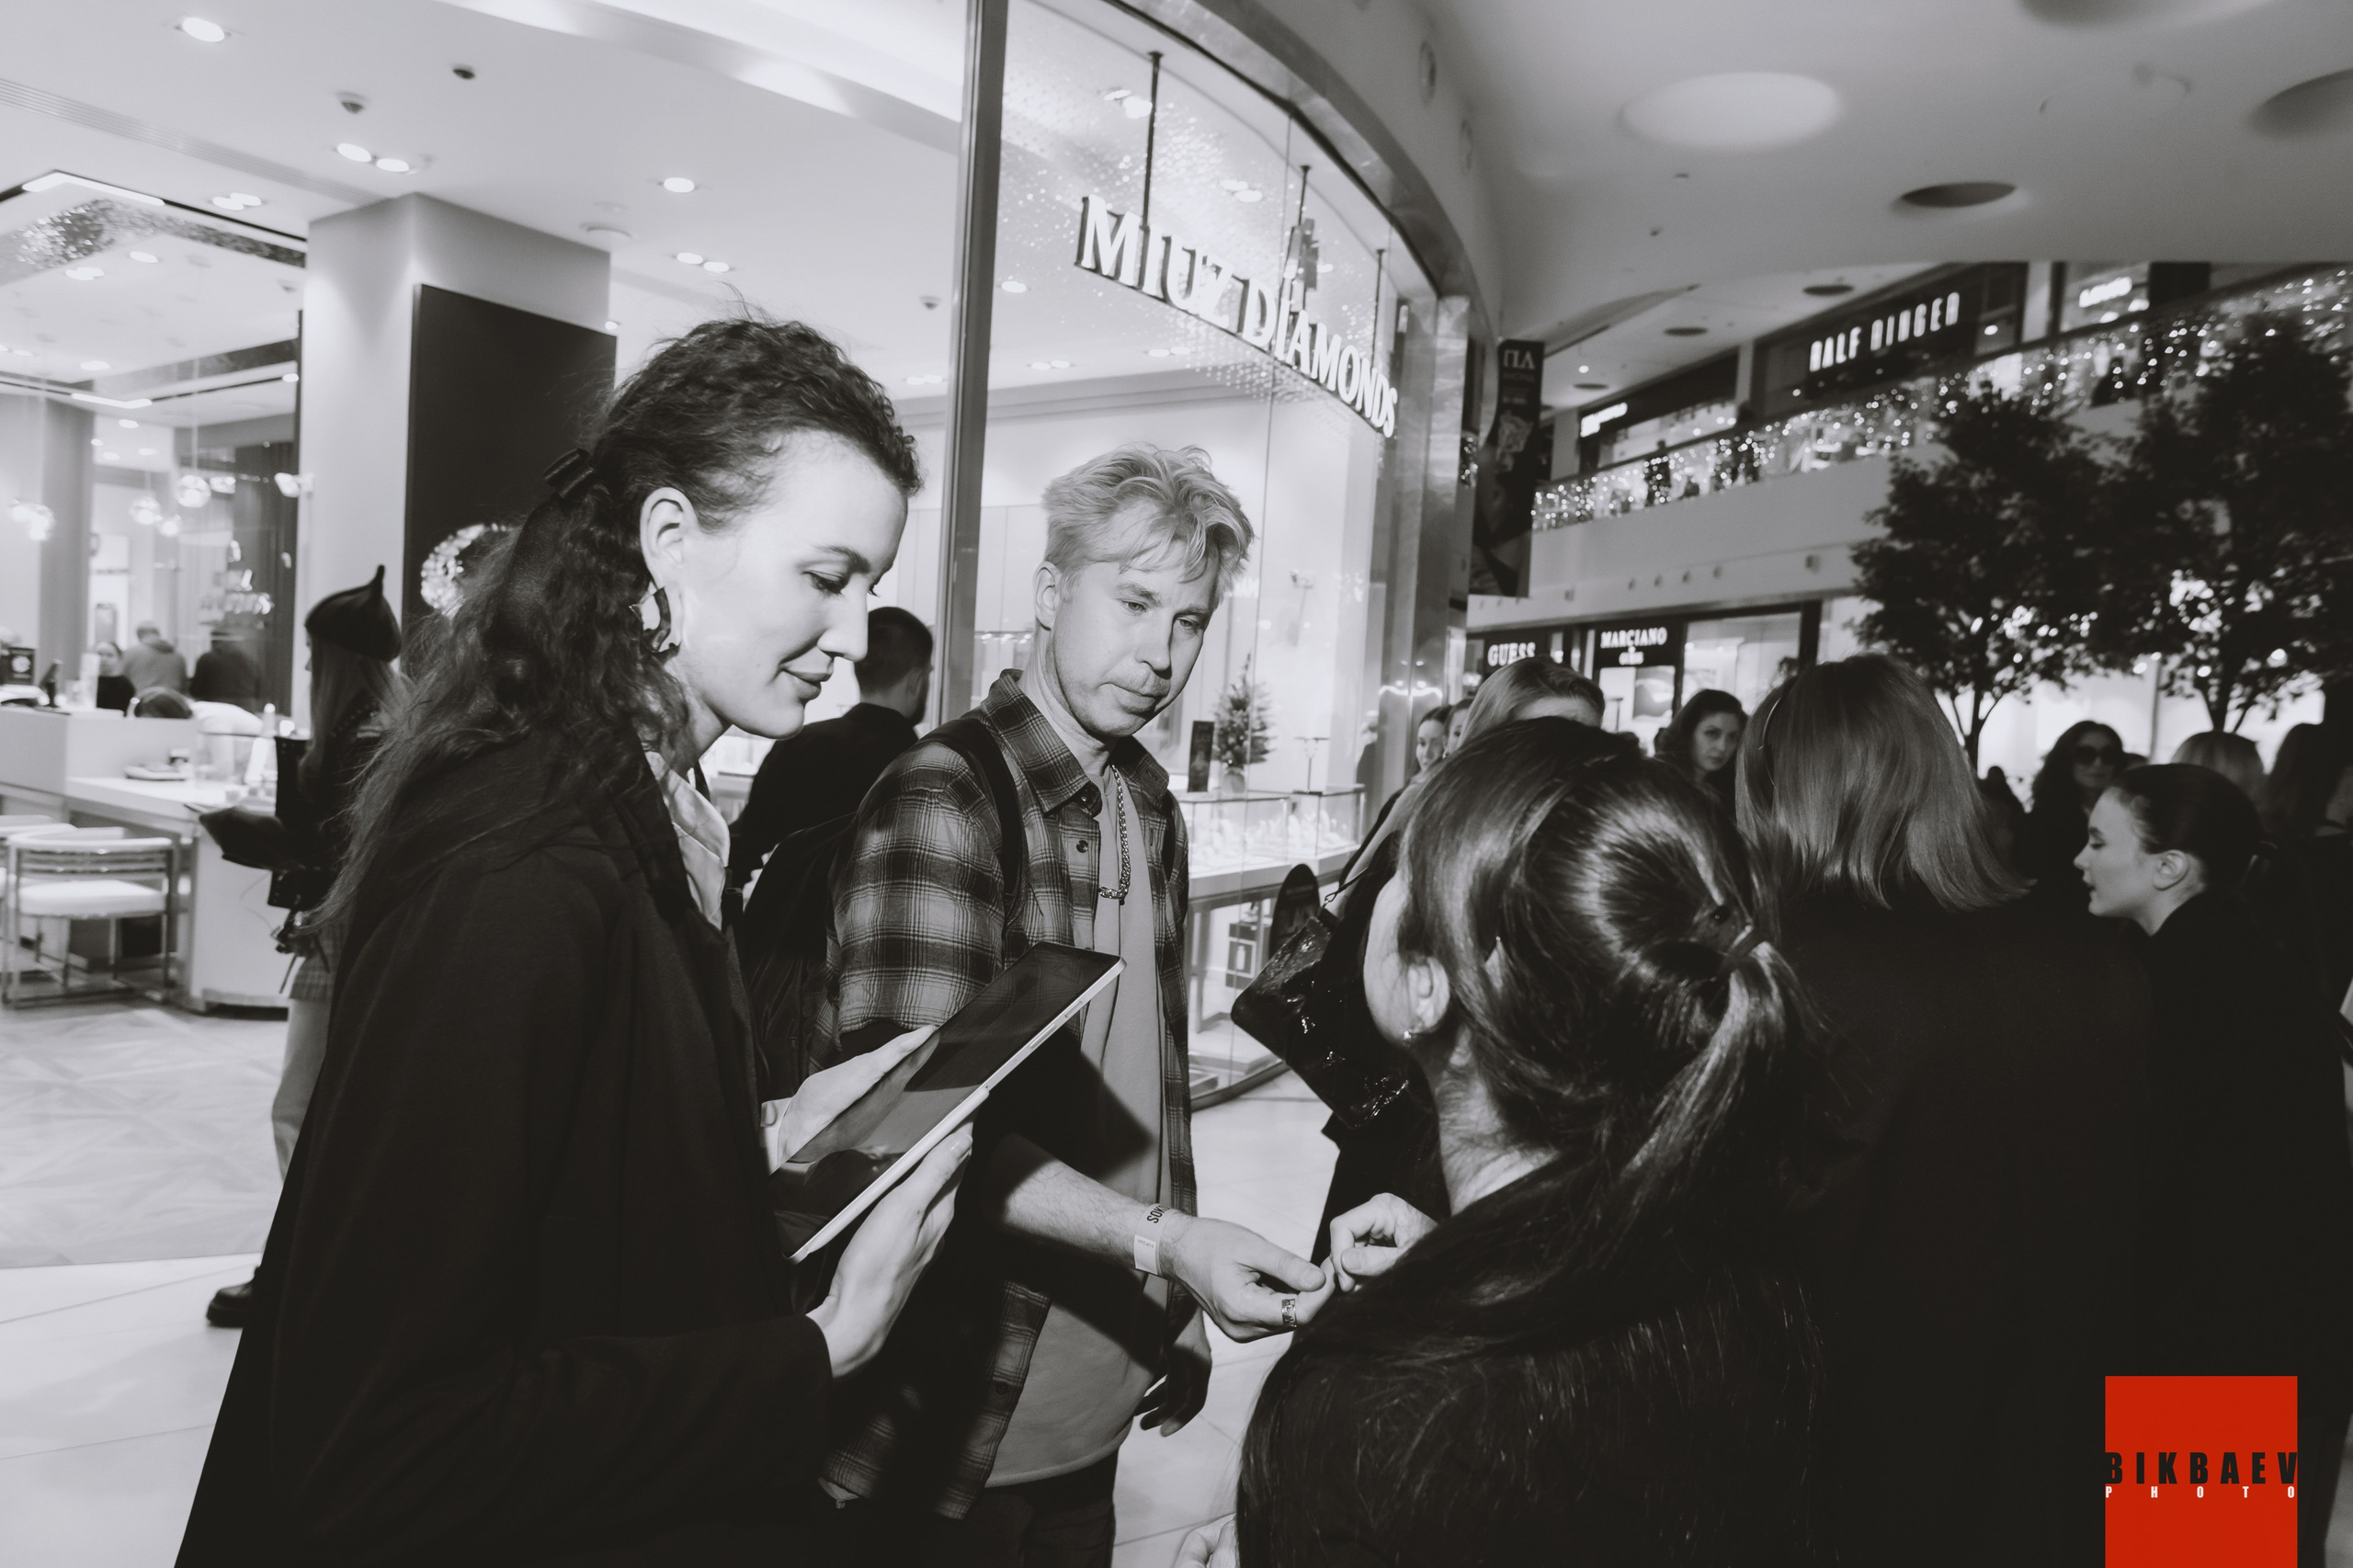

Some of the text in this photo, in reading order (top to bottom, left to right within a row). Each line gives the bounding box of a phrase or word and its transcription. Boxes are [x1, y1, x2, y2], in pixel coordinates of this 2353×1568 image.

[1077, 193, 1399, 438] MIUZ DIAMONDS
[1599, 626, 1668, 649] MARCIANO
[1487, 642, 1537, 667] GUESS
